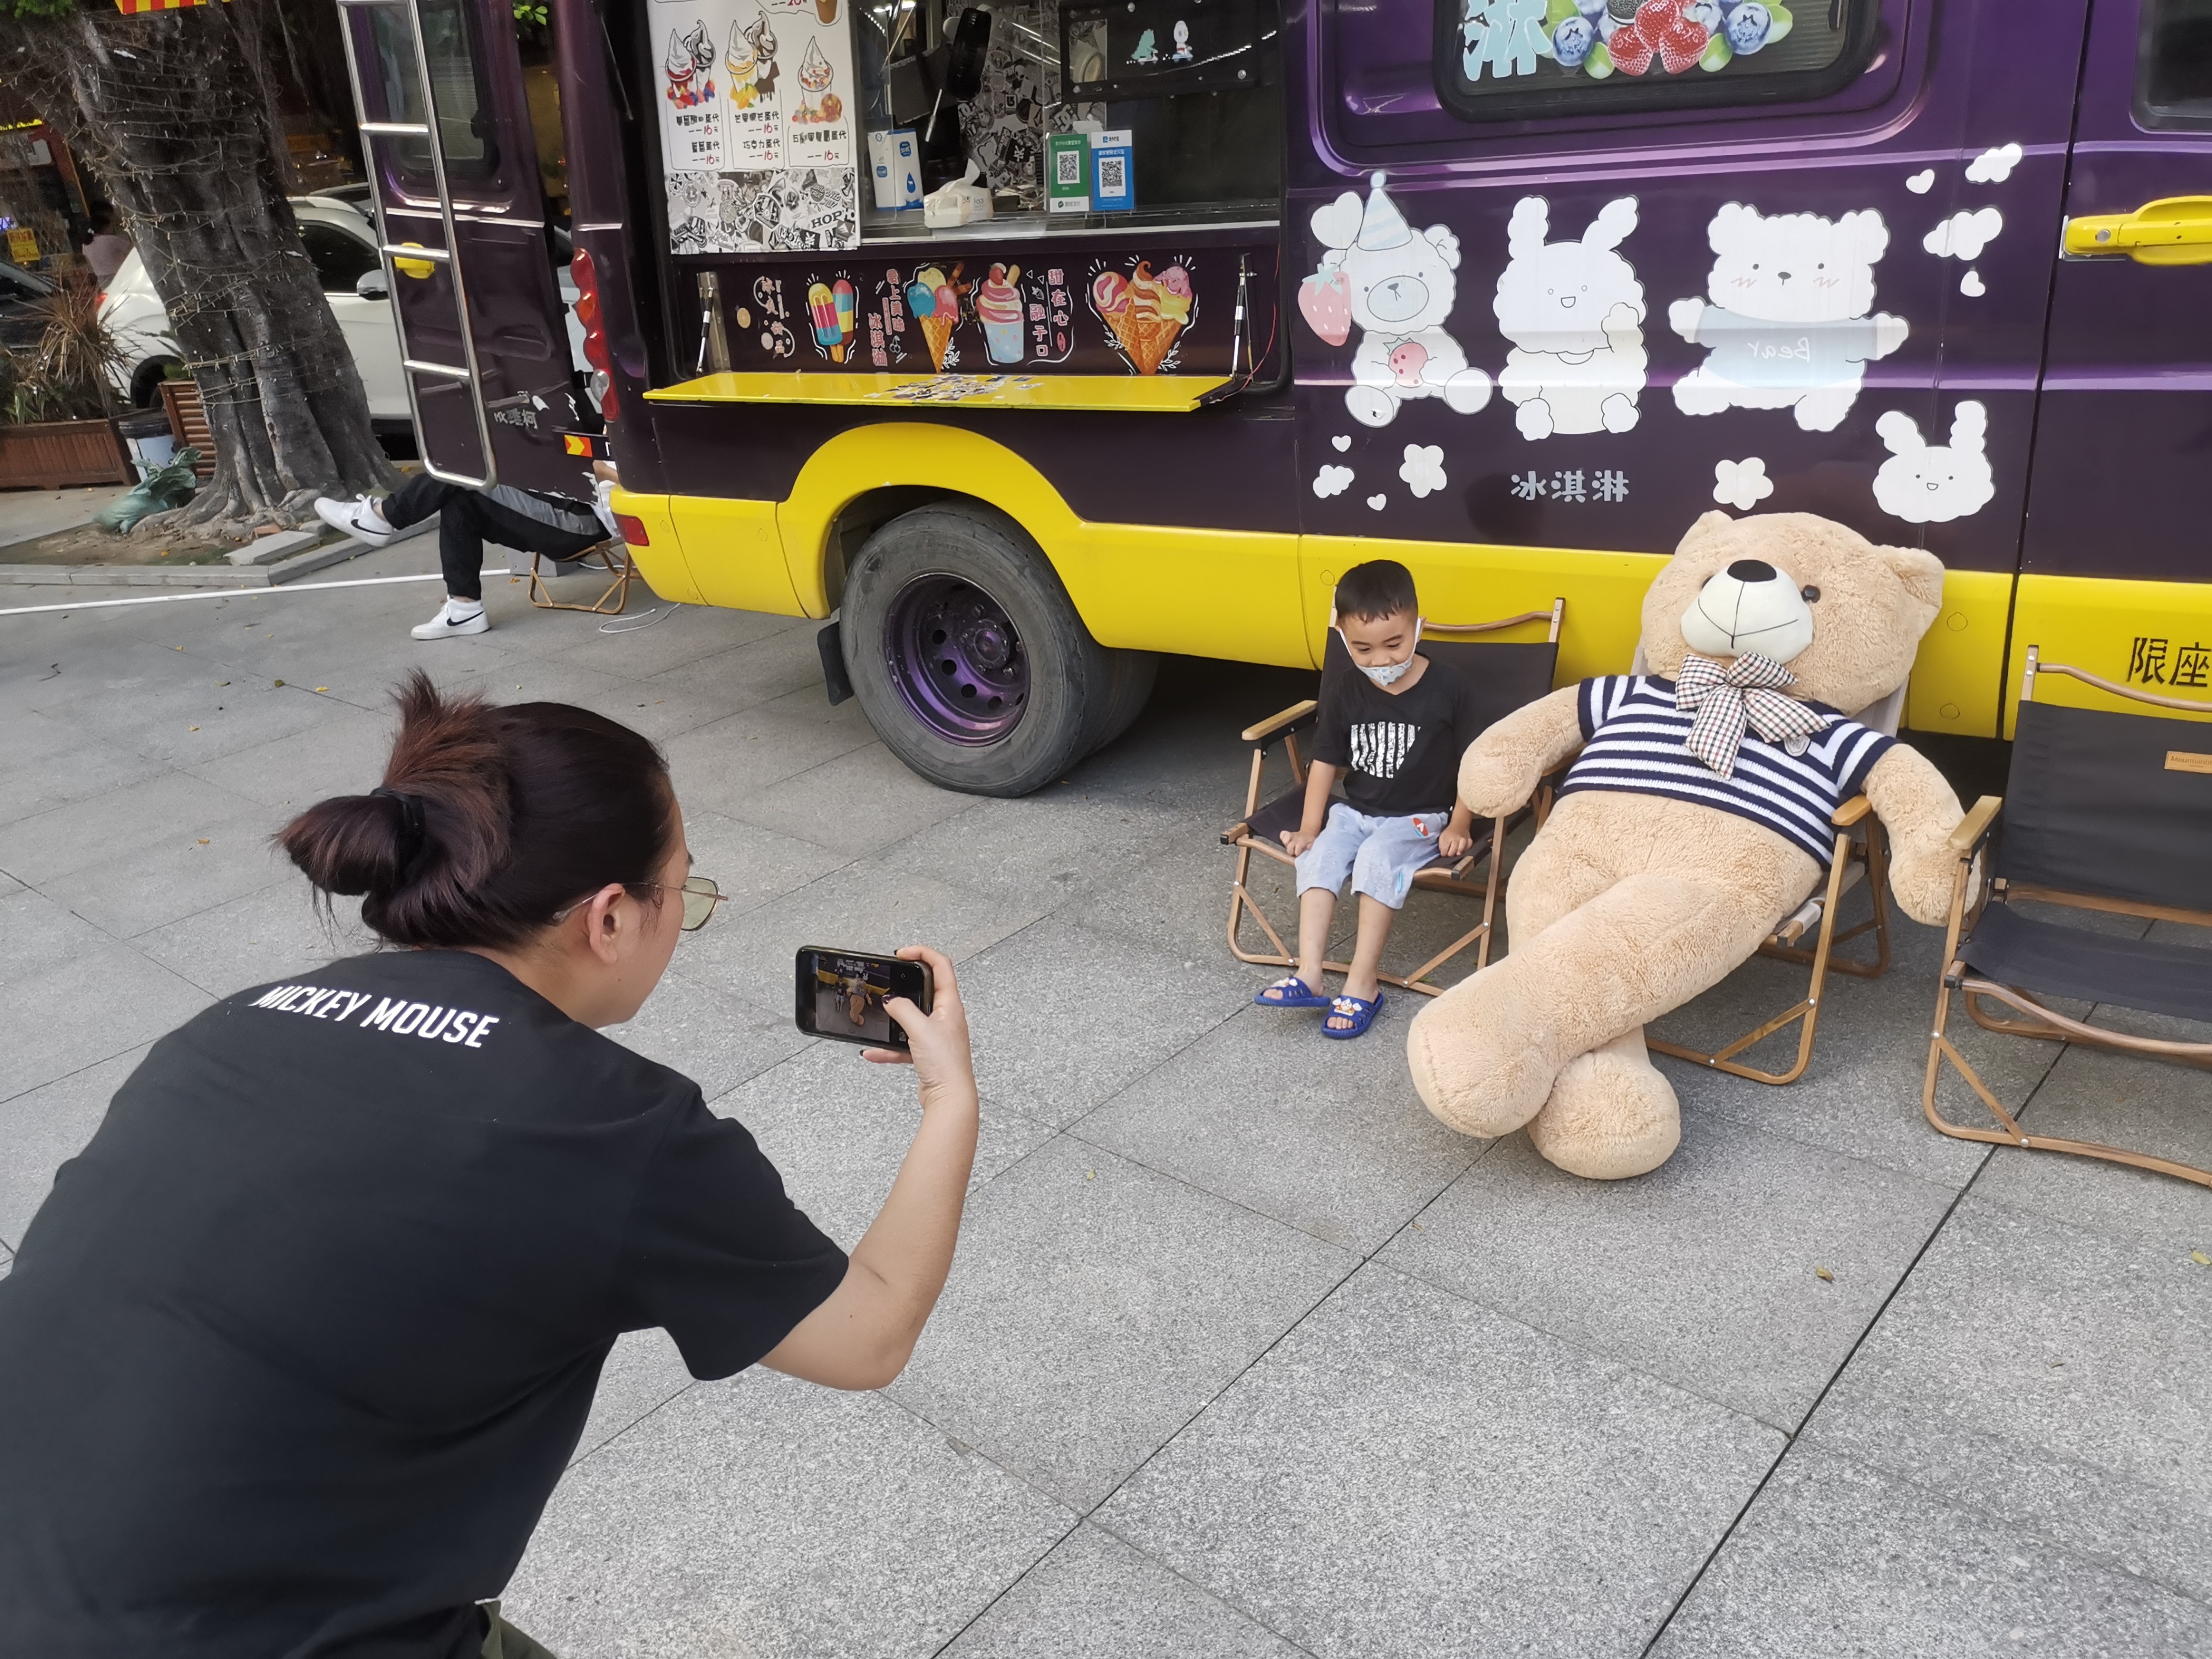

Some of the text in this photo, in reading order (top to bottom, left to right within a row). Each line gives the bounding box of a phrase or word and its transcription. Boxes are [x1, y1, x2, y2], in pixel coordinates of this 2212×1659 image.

[1048, 269, 1069, 326] 甜在心
[1029, 304, 1048, 357] 融于口
[1510, 469, 1630, 503] 冰淇淋
[2126, 637, 2212, 688] 限座
[247, 985, 500, 1048] MICKEY MOUSE
